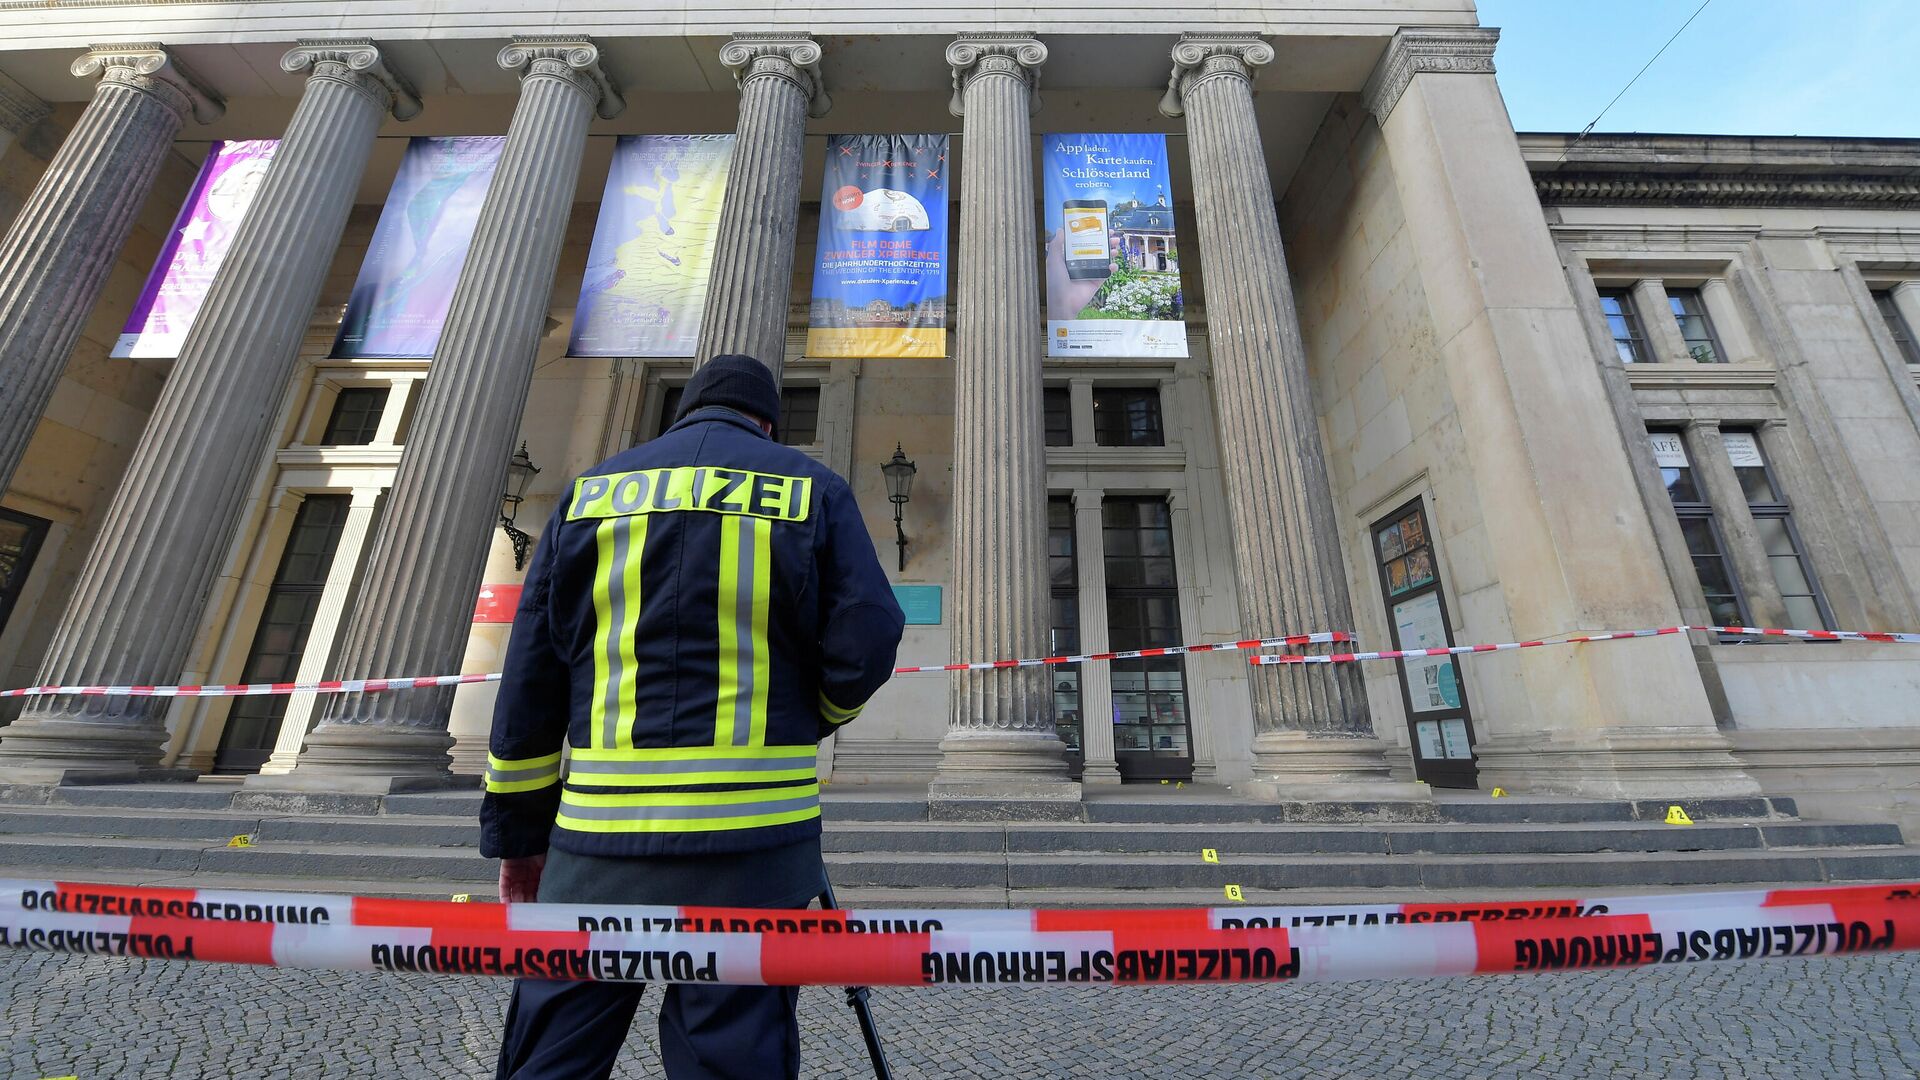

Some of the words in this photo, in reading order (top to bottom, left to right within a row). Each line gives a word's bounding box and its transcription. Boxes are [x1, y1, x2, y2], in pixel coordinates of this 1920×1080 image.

[1056, 142, 1082, 154] App
[1086, 154, 1122, 165] Karte
[1124, 156, 1156, 166] kaufen.
[1062, 167, 1150, 178] Schlösserland
[851, 240, 877, 248] FILM
[880, 240, 912, 249] DOME
[824, 250, 876, 260] ZWINGER
[878, 250, 940, 260] XPERIENCE
[834, 260, 924, 268] JAHRHUNDERTHOCHZEIT
[1652, 437, 1680, 452] AFÉ
[572, 469, 804, 518] POLIZEI
[1677, 811, 1684, 819] 2
[1208, 851, 1213, 859] 4
[1231, 887, 1237, 896] 6
[1514, 920, 1895, 972] POLIZEIABSPERRUNG
[371, 943, 720, 982] POLIZEIABSPERRUNG
[921, 947, 1300, 984] POLIZEIABSPERRUNG
